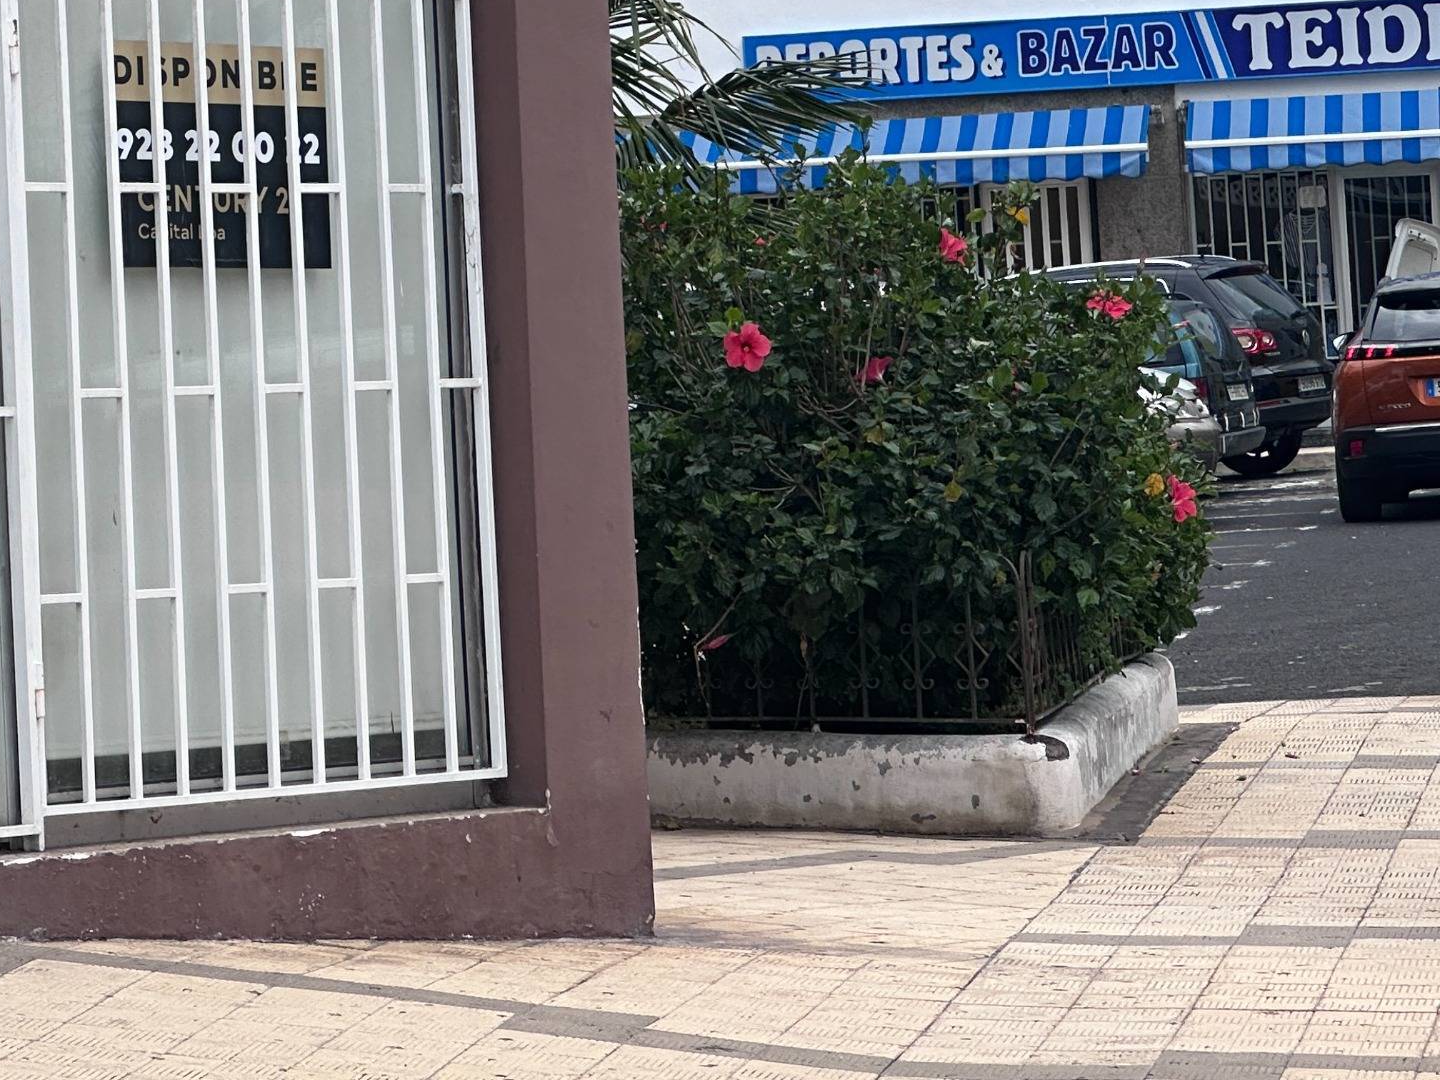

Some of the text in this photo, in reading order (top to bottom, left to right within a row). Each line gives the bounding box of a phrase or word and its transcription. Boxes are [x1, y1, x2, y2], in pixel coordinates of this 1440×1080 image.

[1017, 22, 1179, 77] BAZAR
[114, 55, 318, 92] DIPNBE
[185, 129, 221, 162] 22
[137, 184, 269, 214] CNURY
[138, 222, 194, 240] Caital
